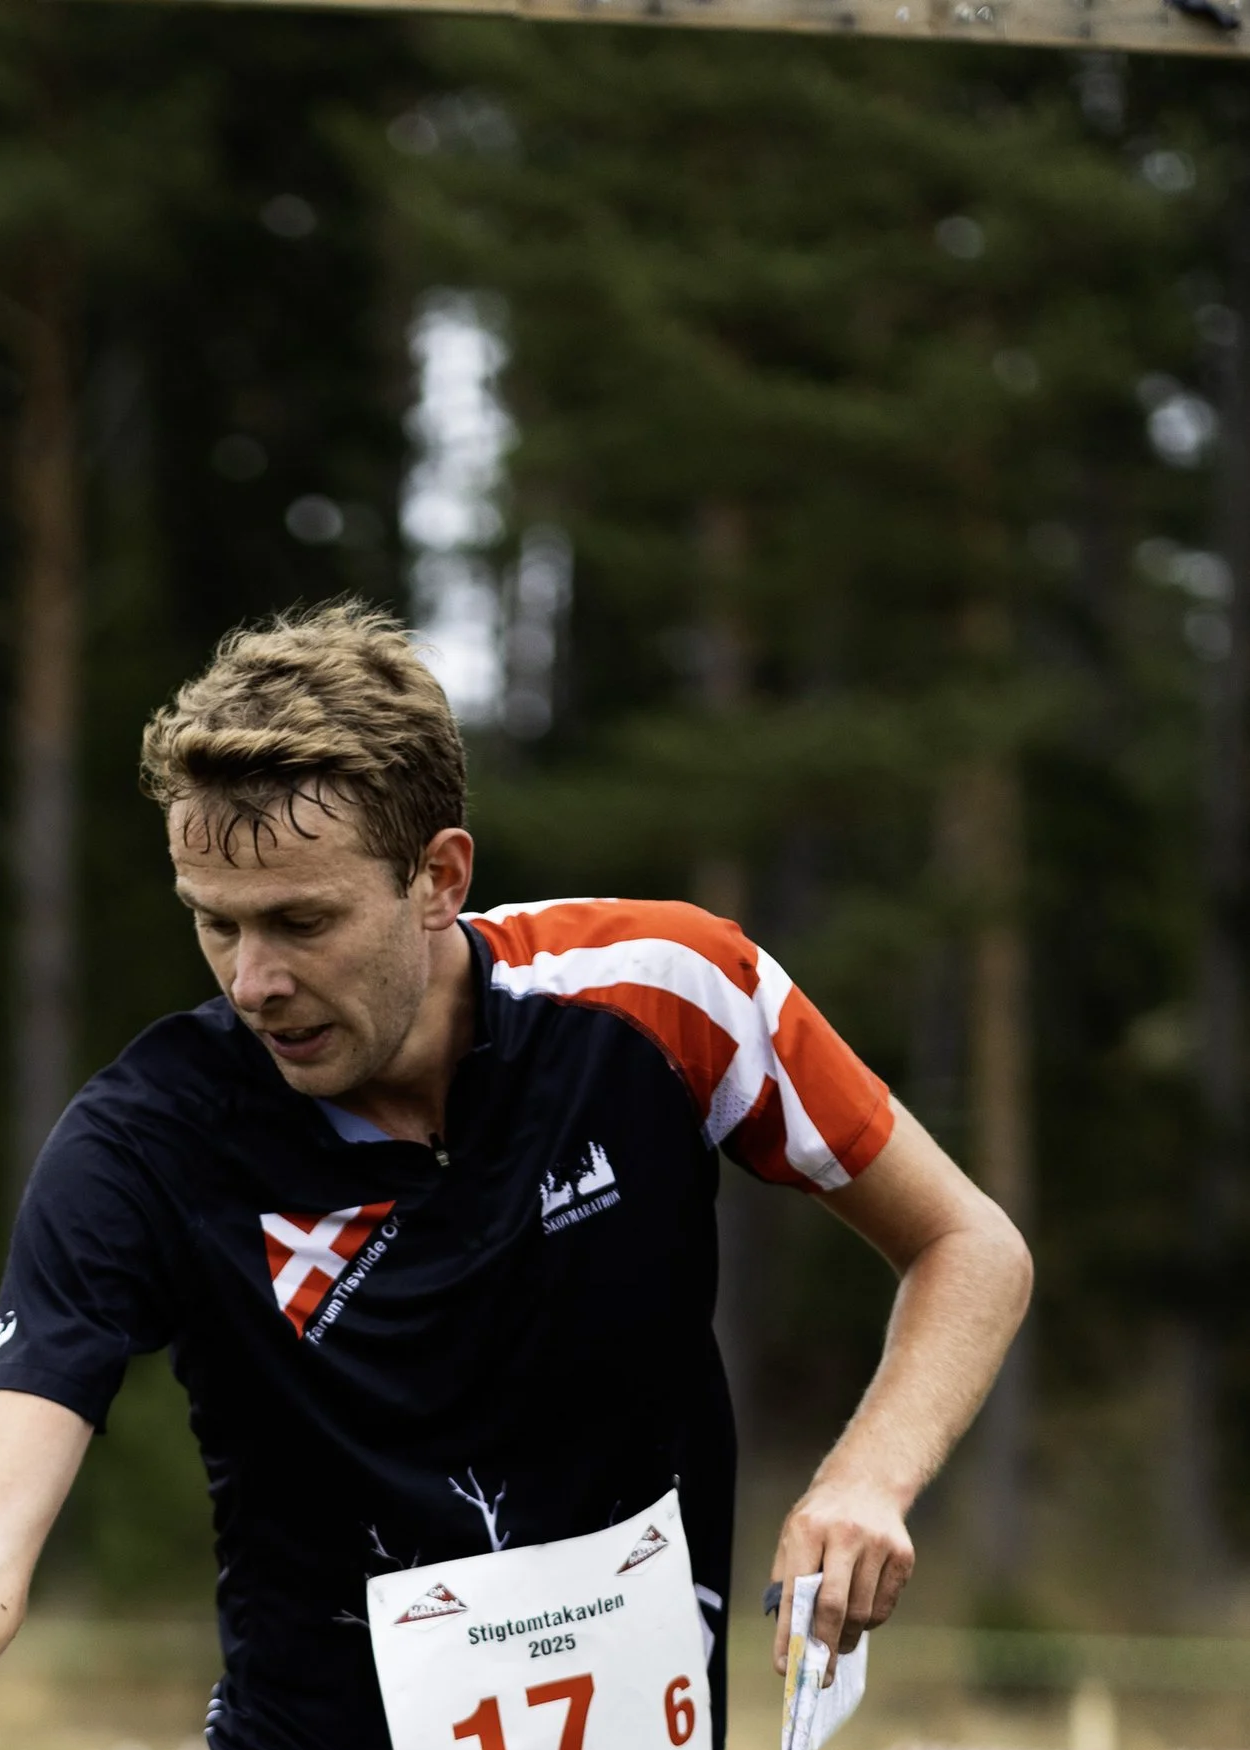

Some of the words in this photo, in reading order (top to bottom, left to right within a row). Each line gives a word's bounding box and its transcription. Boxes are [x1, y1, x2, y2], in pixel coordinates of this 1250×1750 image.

[467, 1593, 626, 1646] Stigtomtakavlen
[528, 1632, 577, 1659] 2025
[664, 1674, 696, 1747] 6
